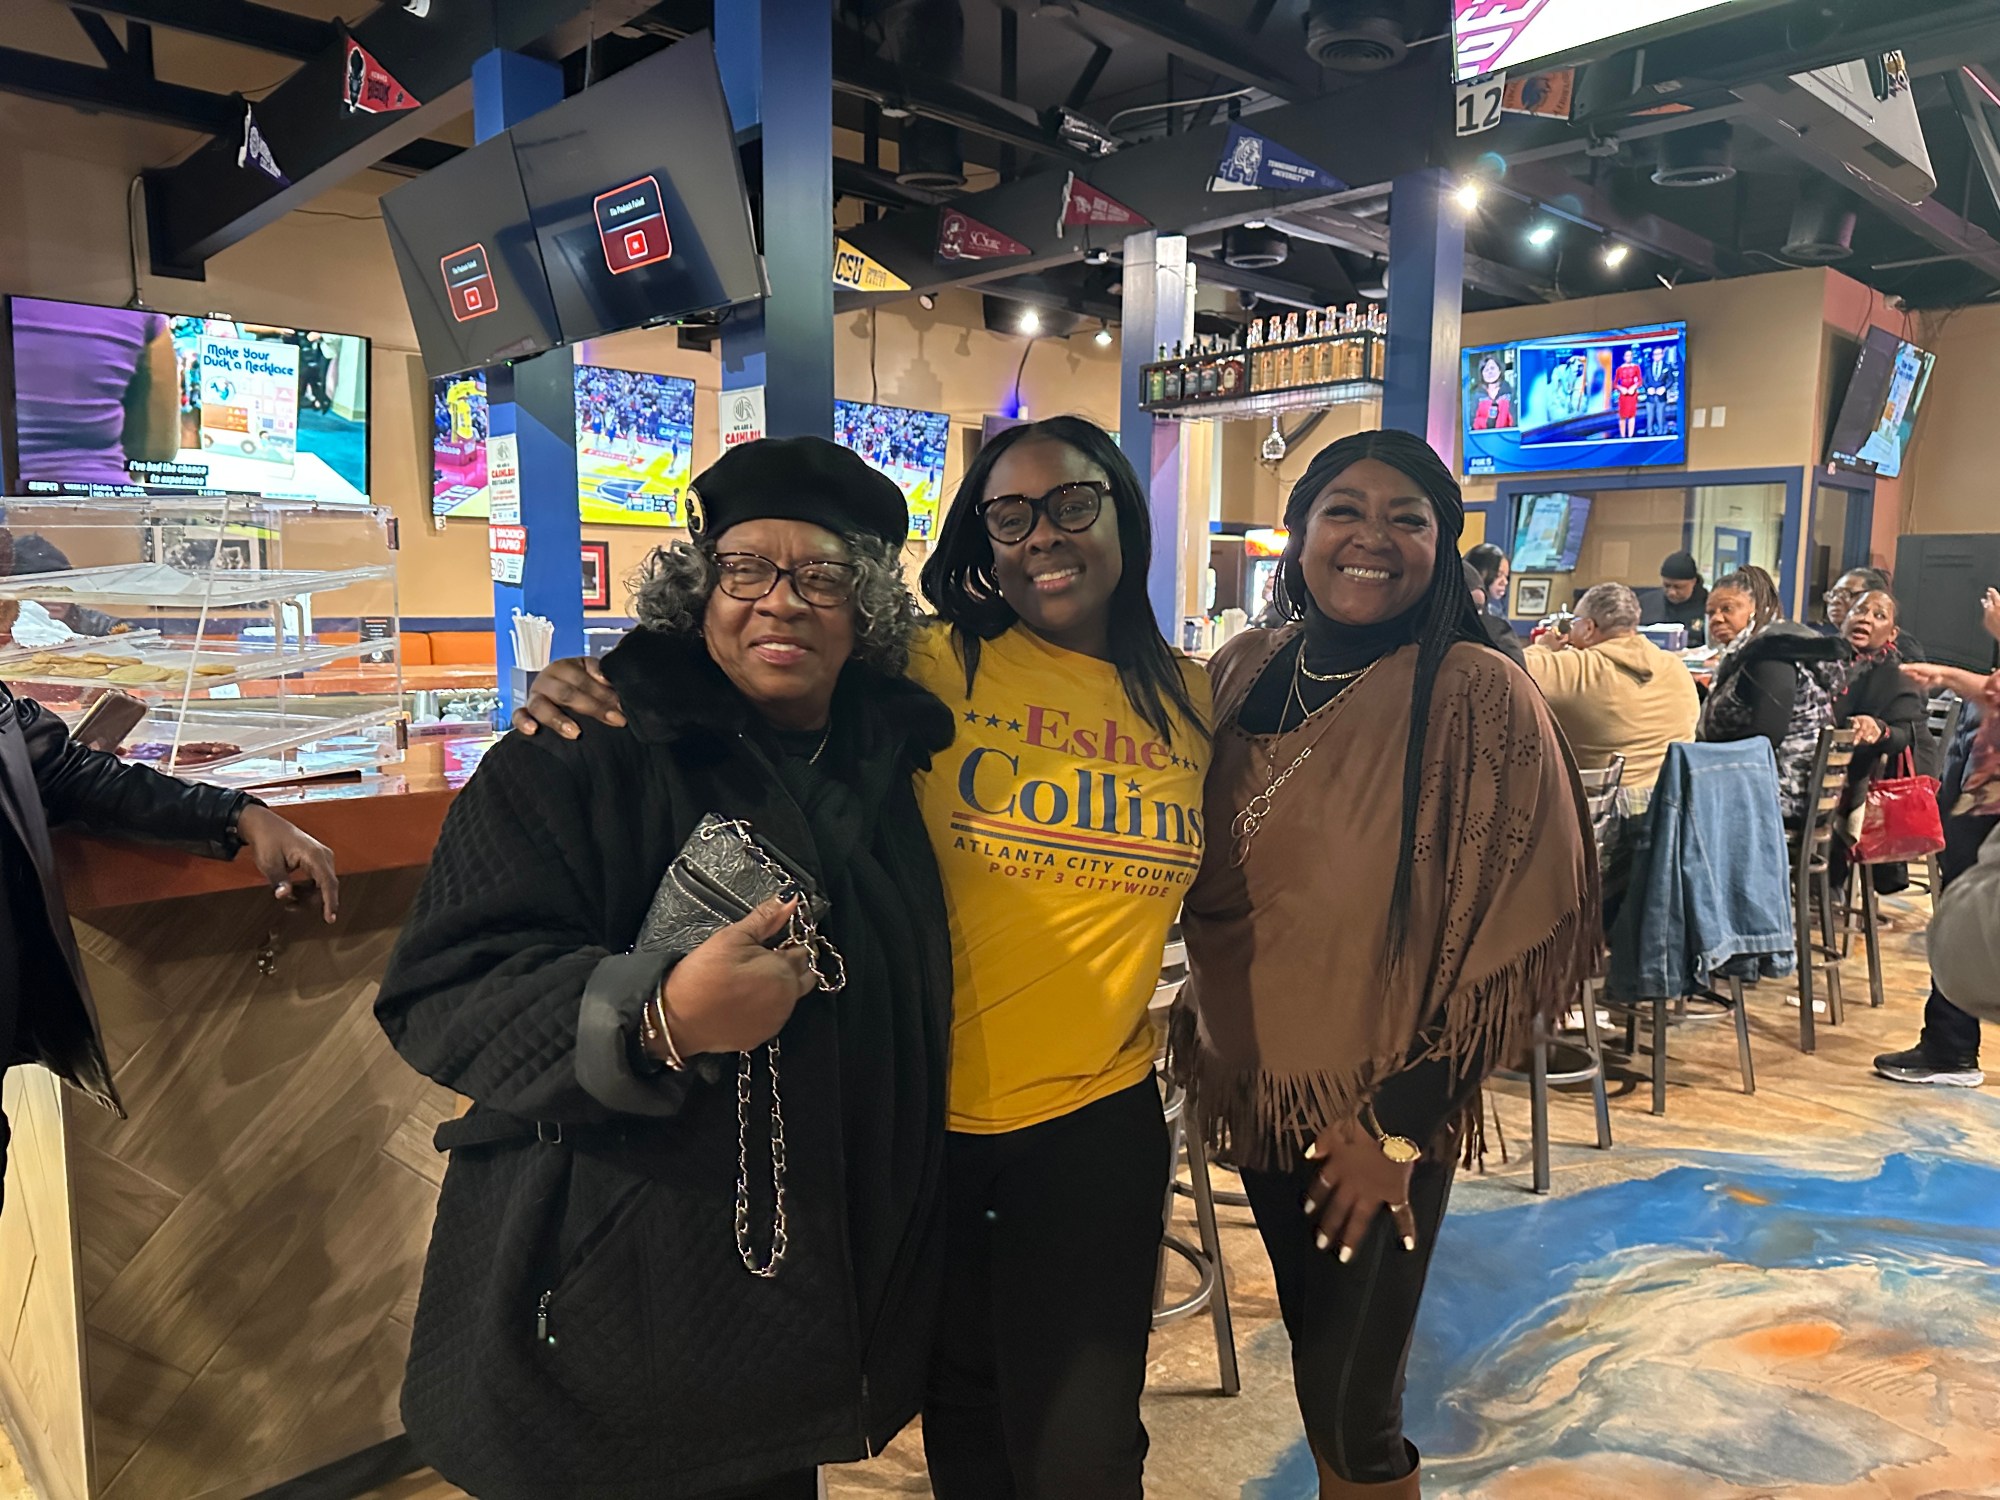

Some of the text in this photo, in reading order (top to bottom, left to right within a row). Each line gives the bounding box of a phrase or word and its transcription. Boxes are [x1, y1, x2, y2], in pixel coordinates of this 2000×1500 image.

[1458, 87, 1502, 132] 12
[836, 252, 864, 284] CSU
[204, 355, 294, 376] Duck a Necklace
[208, 344, 270, 360] Make Your
[438, 518, 446, 529] 3
[958, 747, 1203, 849] Collins
[954, 836, 1192, 886] ATLANTA CITY COUNCIL
[989, 862, 1170, 898] POST 3 CITYWIDE
